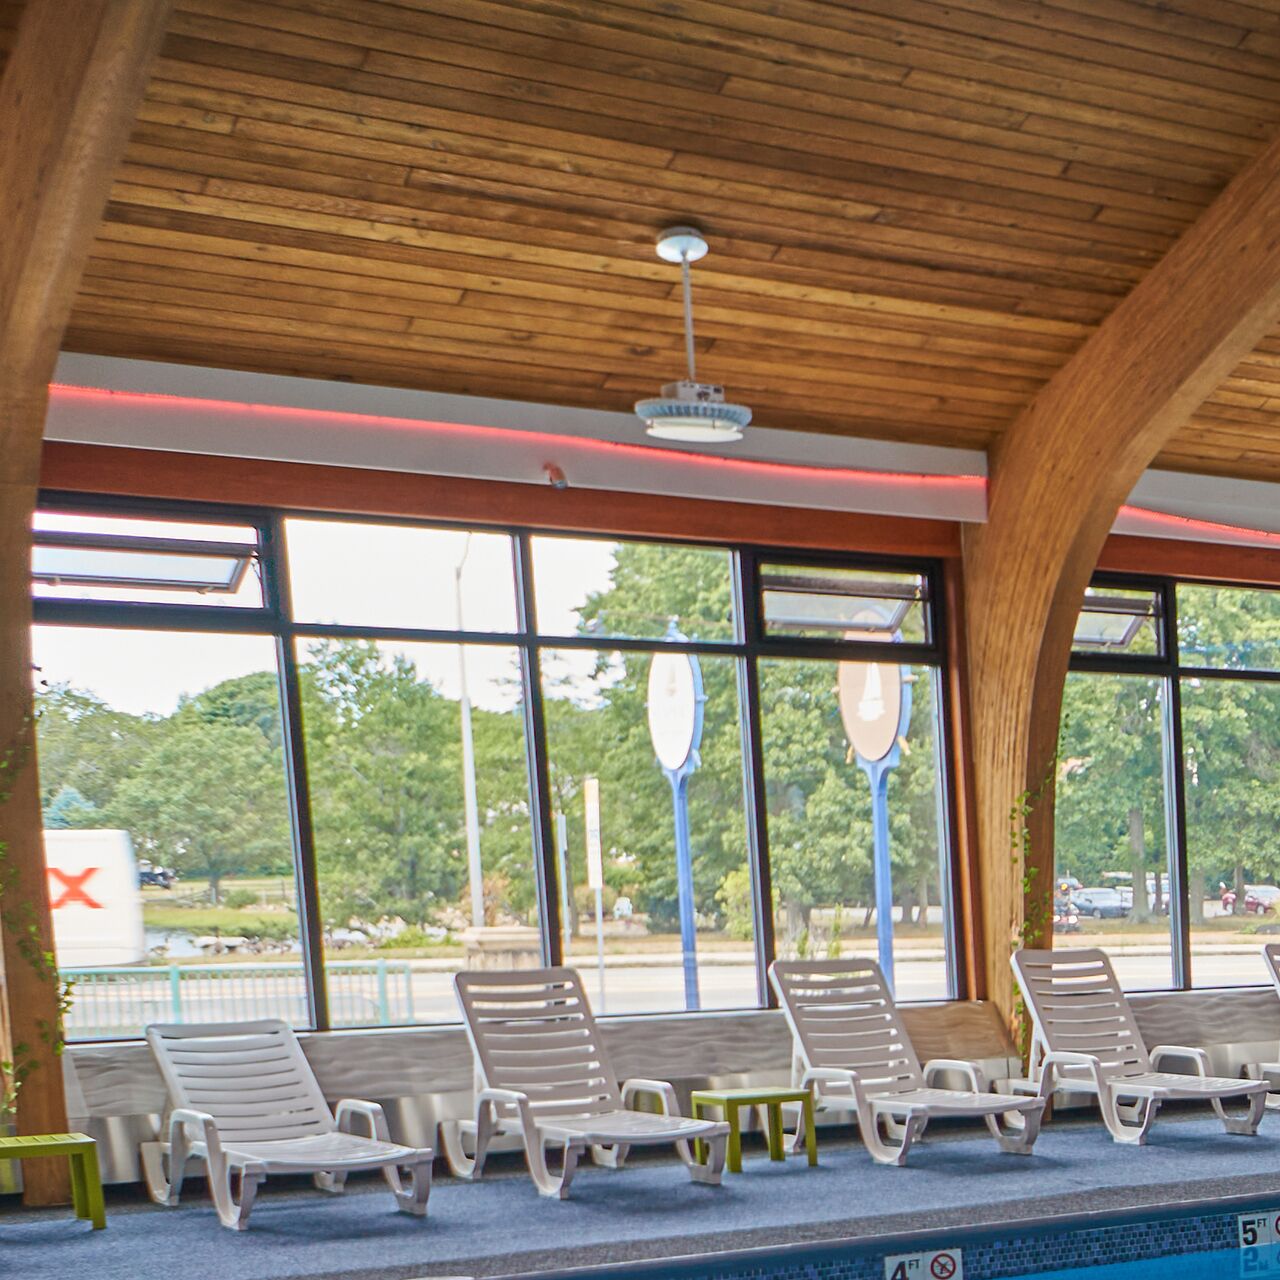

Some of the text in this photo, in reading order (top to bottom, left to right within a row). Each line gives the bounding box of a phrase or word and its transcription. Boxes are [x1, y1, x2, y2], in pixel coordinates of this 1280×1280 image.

[1242, 1218, 1267, 1245] 5 FT
[909, 1259, 920, 1270] FT
